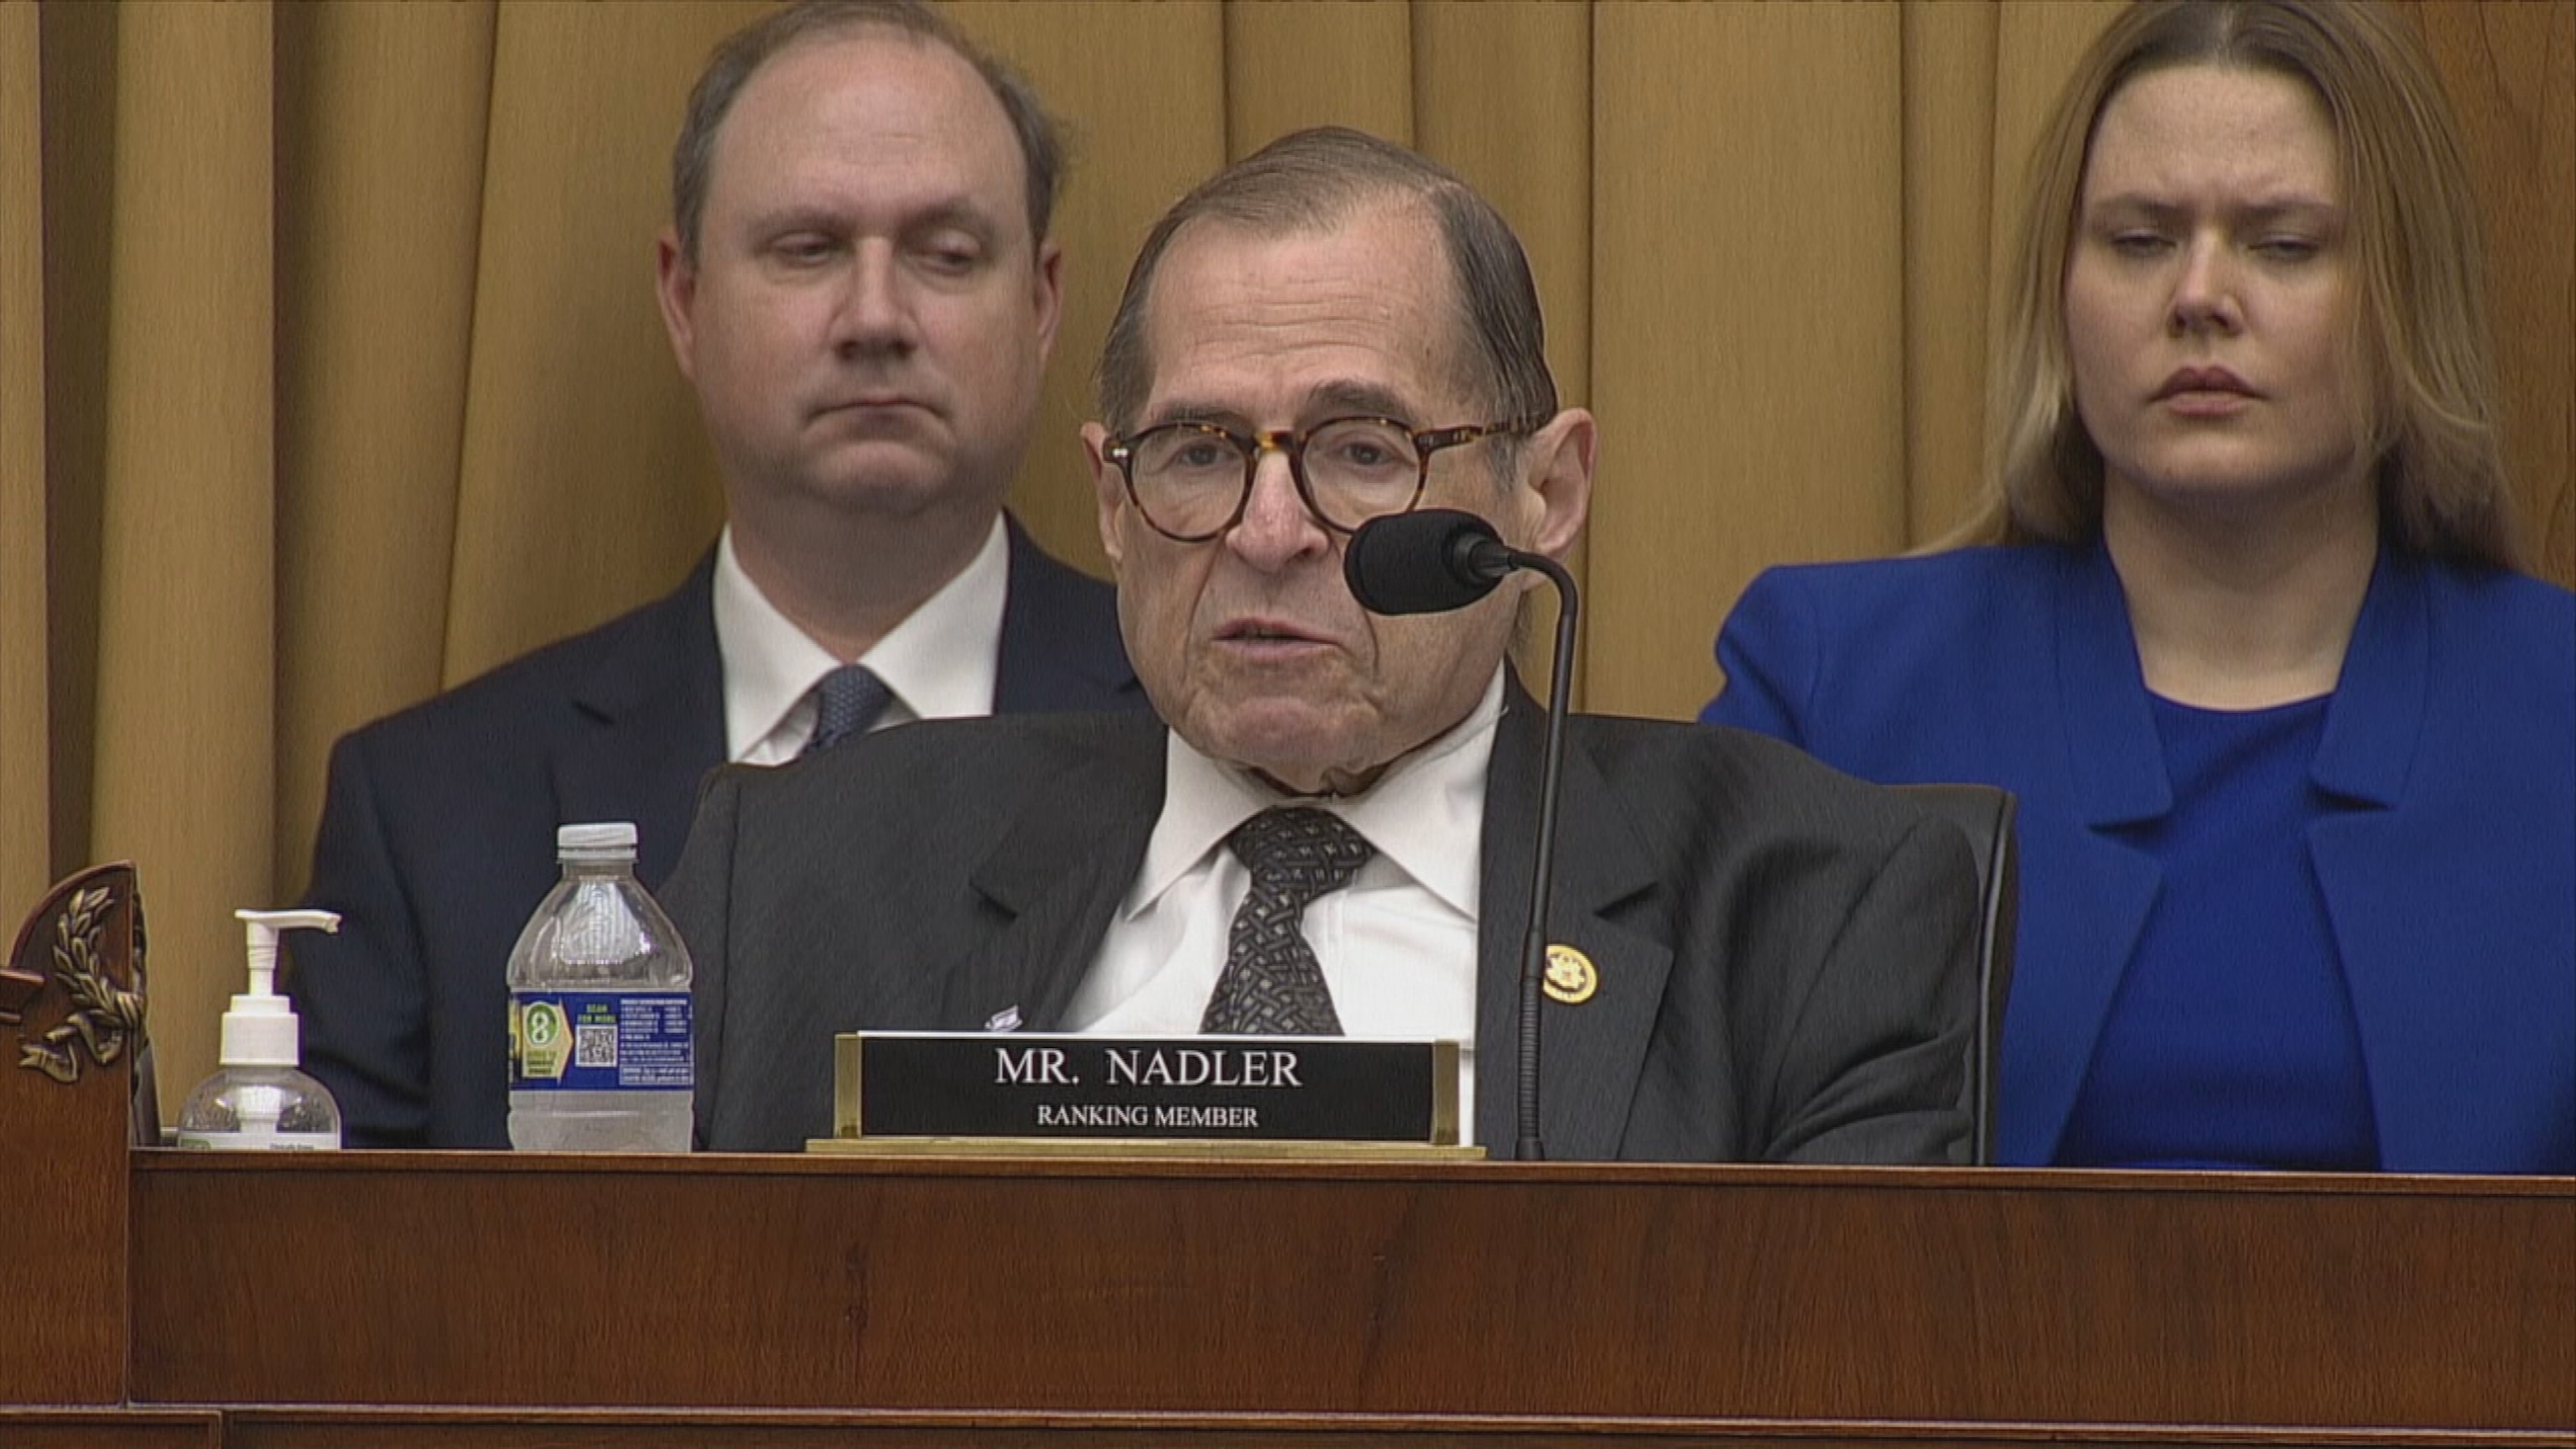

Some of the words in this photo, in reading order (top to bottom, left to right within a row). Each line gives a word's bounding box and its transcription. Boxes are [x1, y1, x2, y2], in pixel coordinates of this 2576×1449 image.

[995, 1047, 1080, 1085] MR.
[1105, 1049, 1303, 1088] NADLER
[1037, 1104, 1149, 1127] RANKING
[1155, 1106, 1259, 1129] MEMBER
